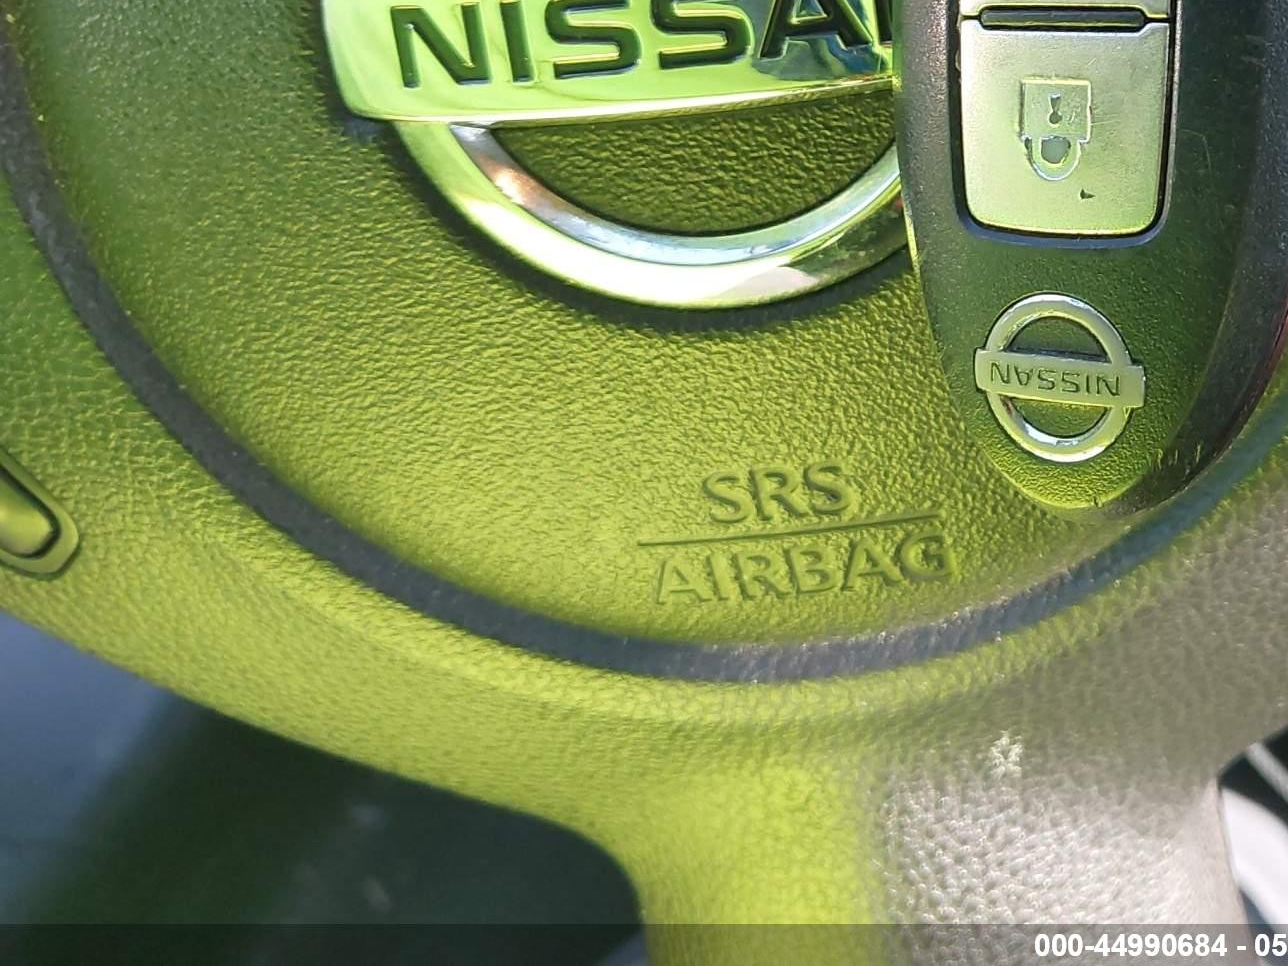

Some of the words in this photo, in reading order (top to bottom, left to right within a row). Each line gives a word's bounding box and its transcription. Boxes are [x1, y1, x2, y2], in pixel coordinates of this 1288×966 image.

[990, 361, 1121, 397] NISSAN
[703, 460, 852, 523] SRS
[655, 533, 953, 605] AIRBAG
